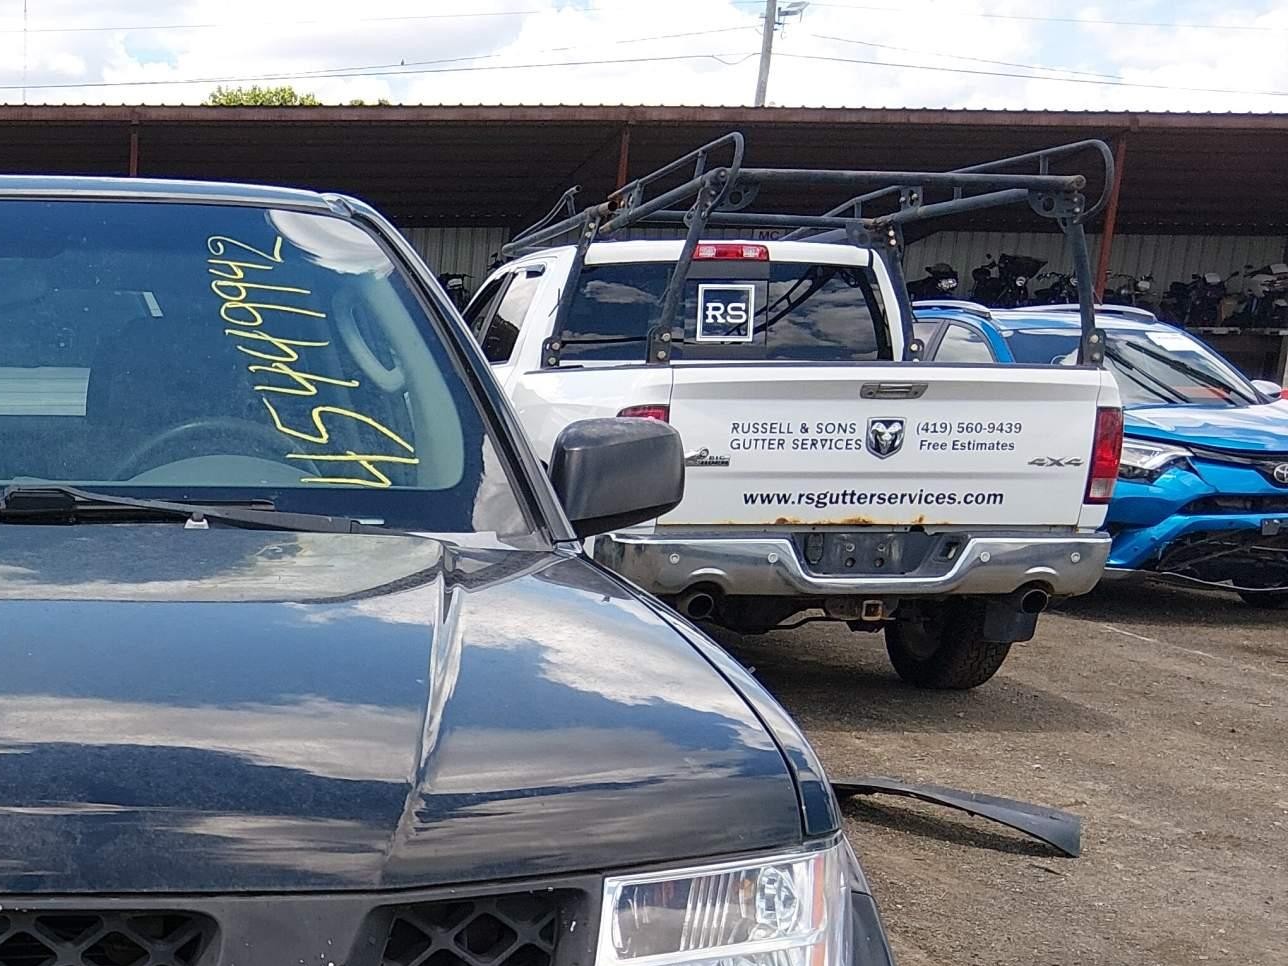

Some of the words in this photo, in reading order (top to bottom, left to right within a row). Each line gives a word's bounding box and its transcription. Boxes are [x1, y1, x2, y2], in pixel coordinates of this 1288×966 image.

[705, 302, 747, 324] RS
[207, 235, 420, 488] 45449942
[731, 422, 793, 434] RUSSELL
[799, 422, 809, 434] &
[816, 422, 856, 434] SONS
[916, 422, 952, 436] (419)
[957, 422, 1022, 434] 560-9439
[730, 438, 785, 450] GUTTER
[792, 438, 862, 450] SERVICES
[919, 440, 947, 451] Free
[951, 440, 1015, 451] Estimates
[743, 489, 1004, 508] www.rsgutterservices.com
